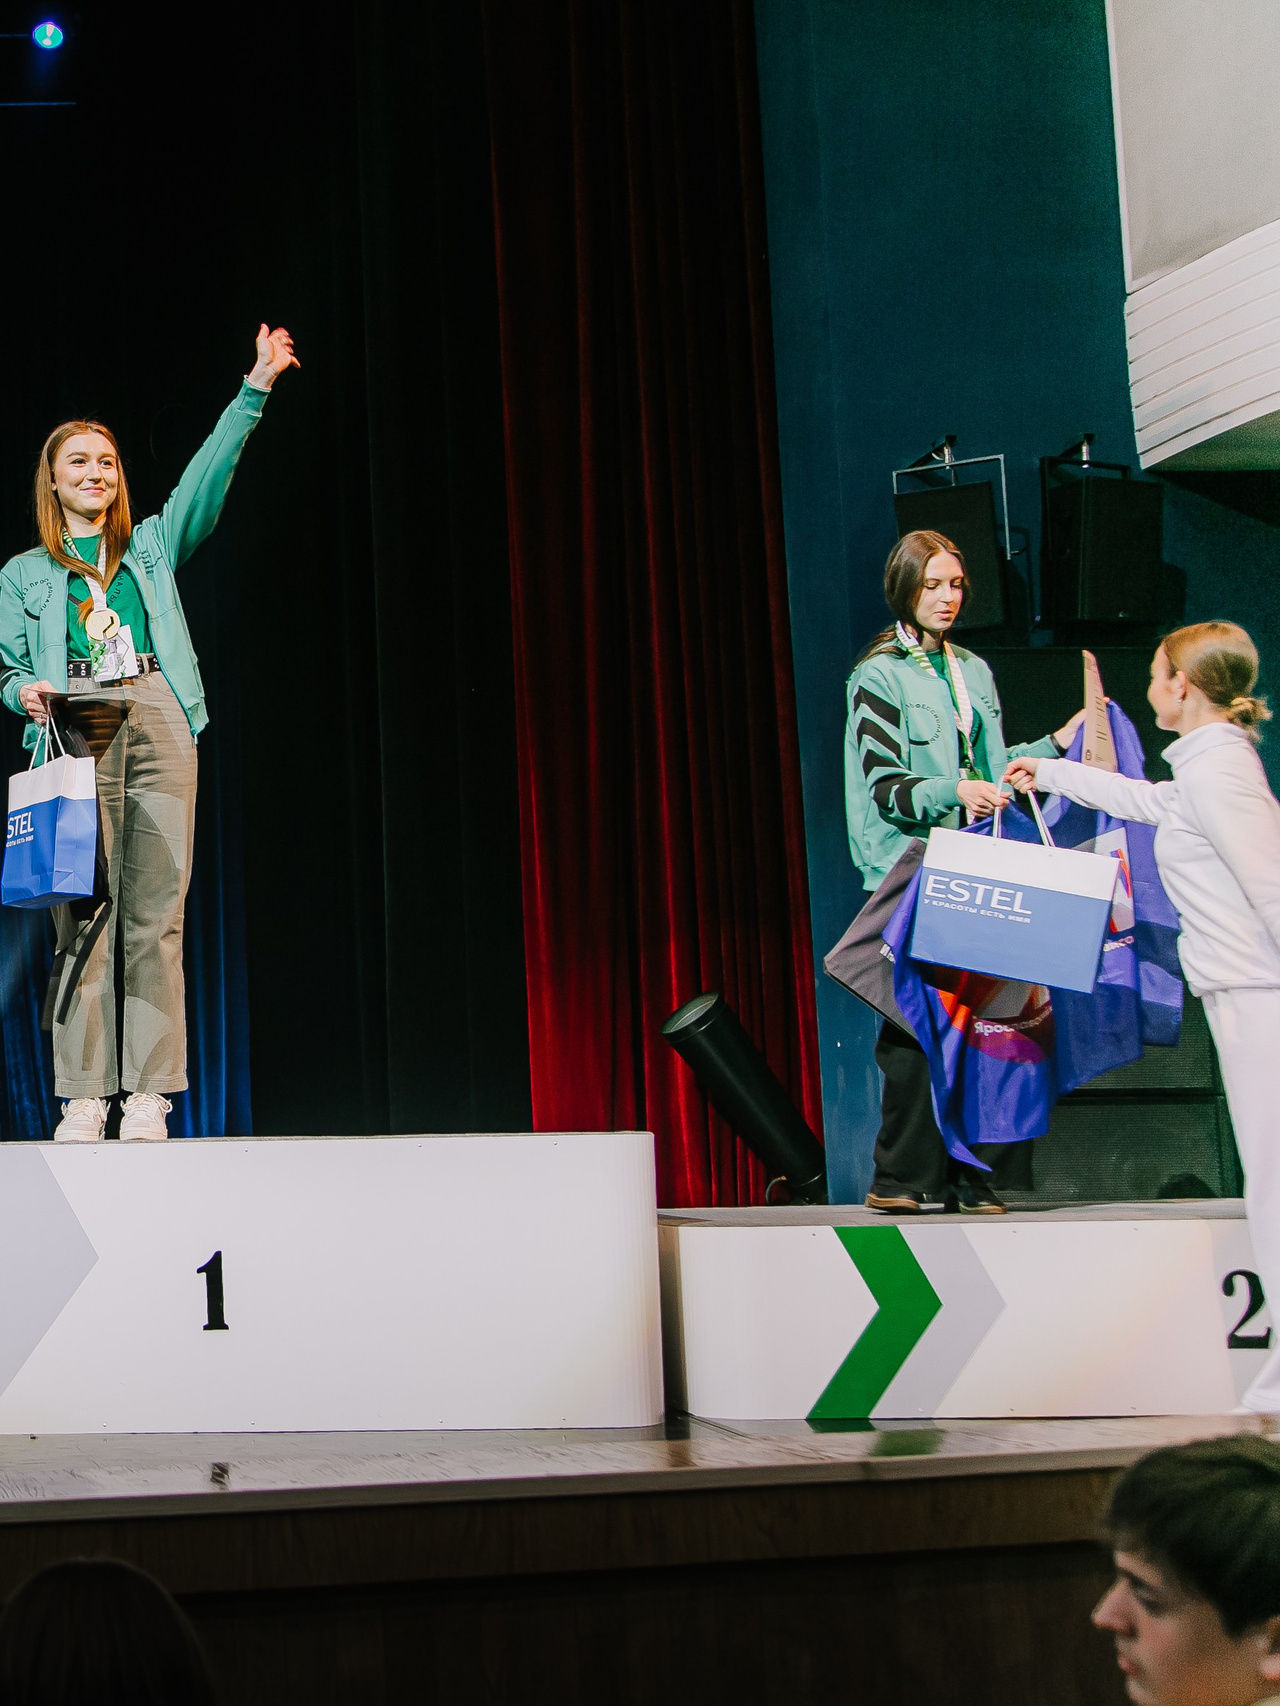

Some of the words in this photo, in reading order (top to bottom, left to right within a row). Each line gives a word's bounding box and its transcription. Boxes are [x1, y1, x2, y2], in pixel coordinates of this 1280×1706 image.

[6, 811, 34, 839] STEL
[924, 874, 1033, 915] ESTEL
[932, 900, 977, 913] КРАСОТЫ
[980, 909, 1006, 919] ЕСТЬ
[1007, 914, 1031, 924] ИМЯ
[196, 1250, 229, 1331] 1
[1222, 1269, 1271, 1349] 2
